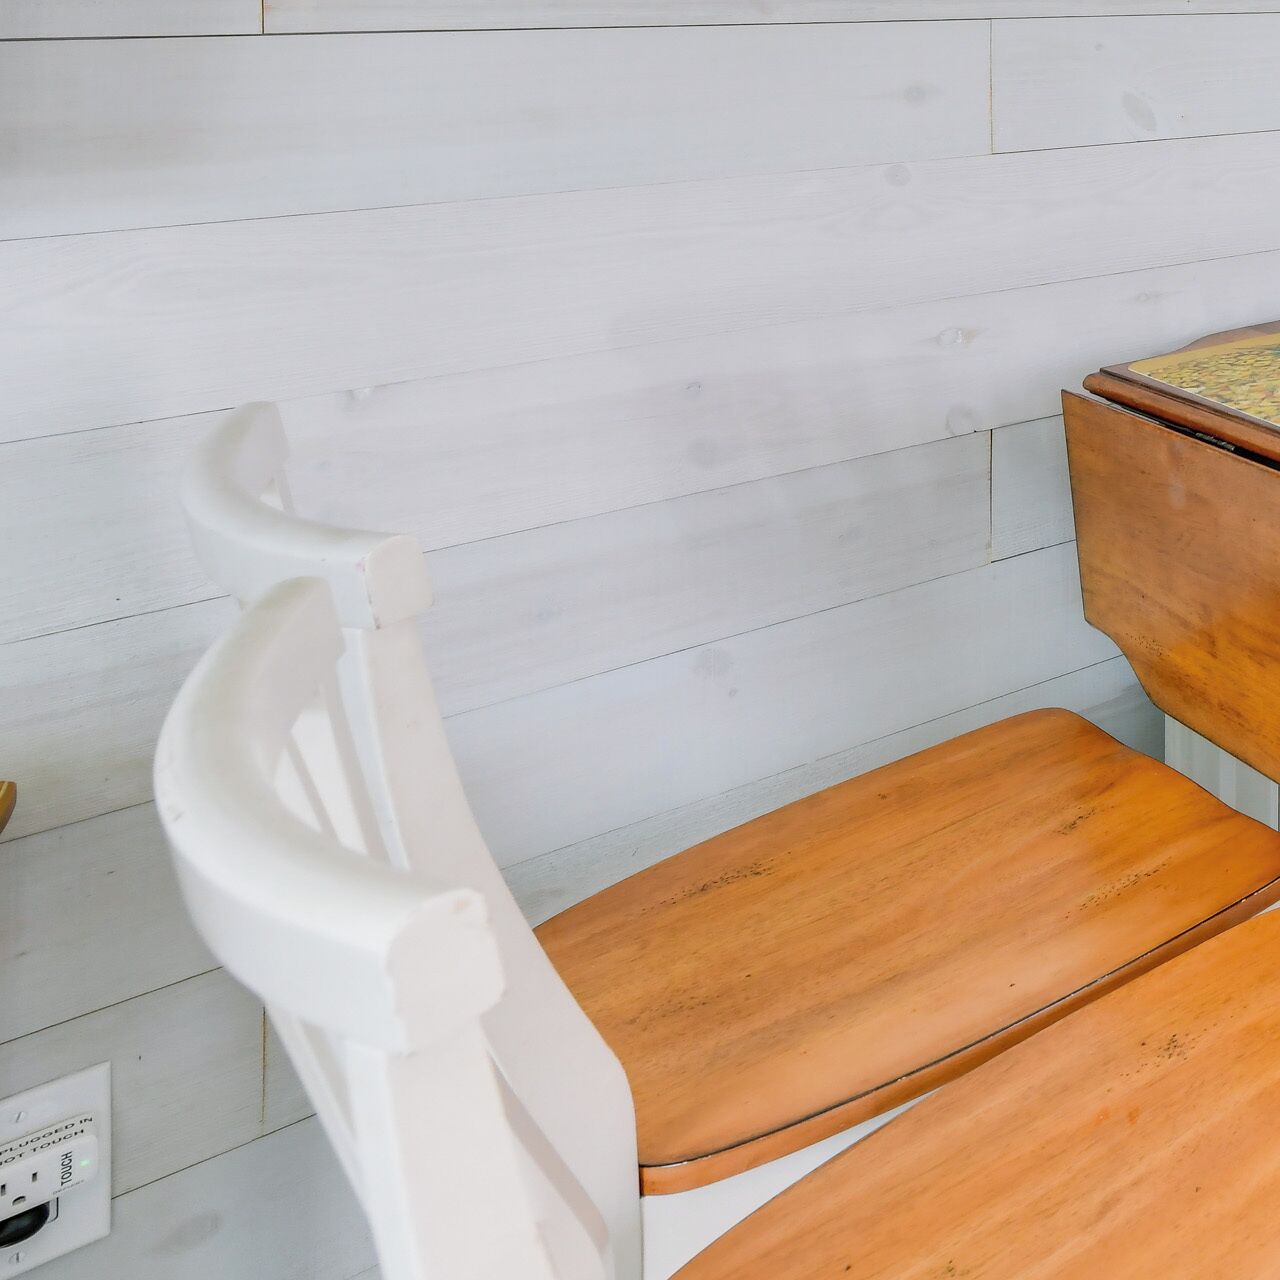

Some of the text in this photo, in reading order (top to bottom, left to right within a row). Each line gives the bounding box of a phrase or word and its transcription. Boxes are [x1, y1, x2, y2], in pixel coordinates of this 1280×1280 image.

[80, 1116, 93, 1124] IN
[0, 1128, 84, 1167] OT TOUCH
[61, 1150, 74, 1187] TOUCH
